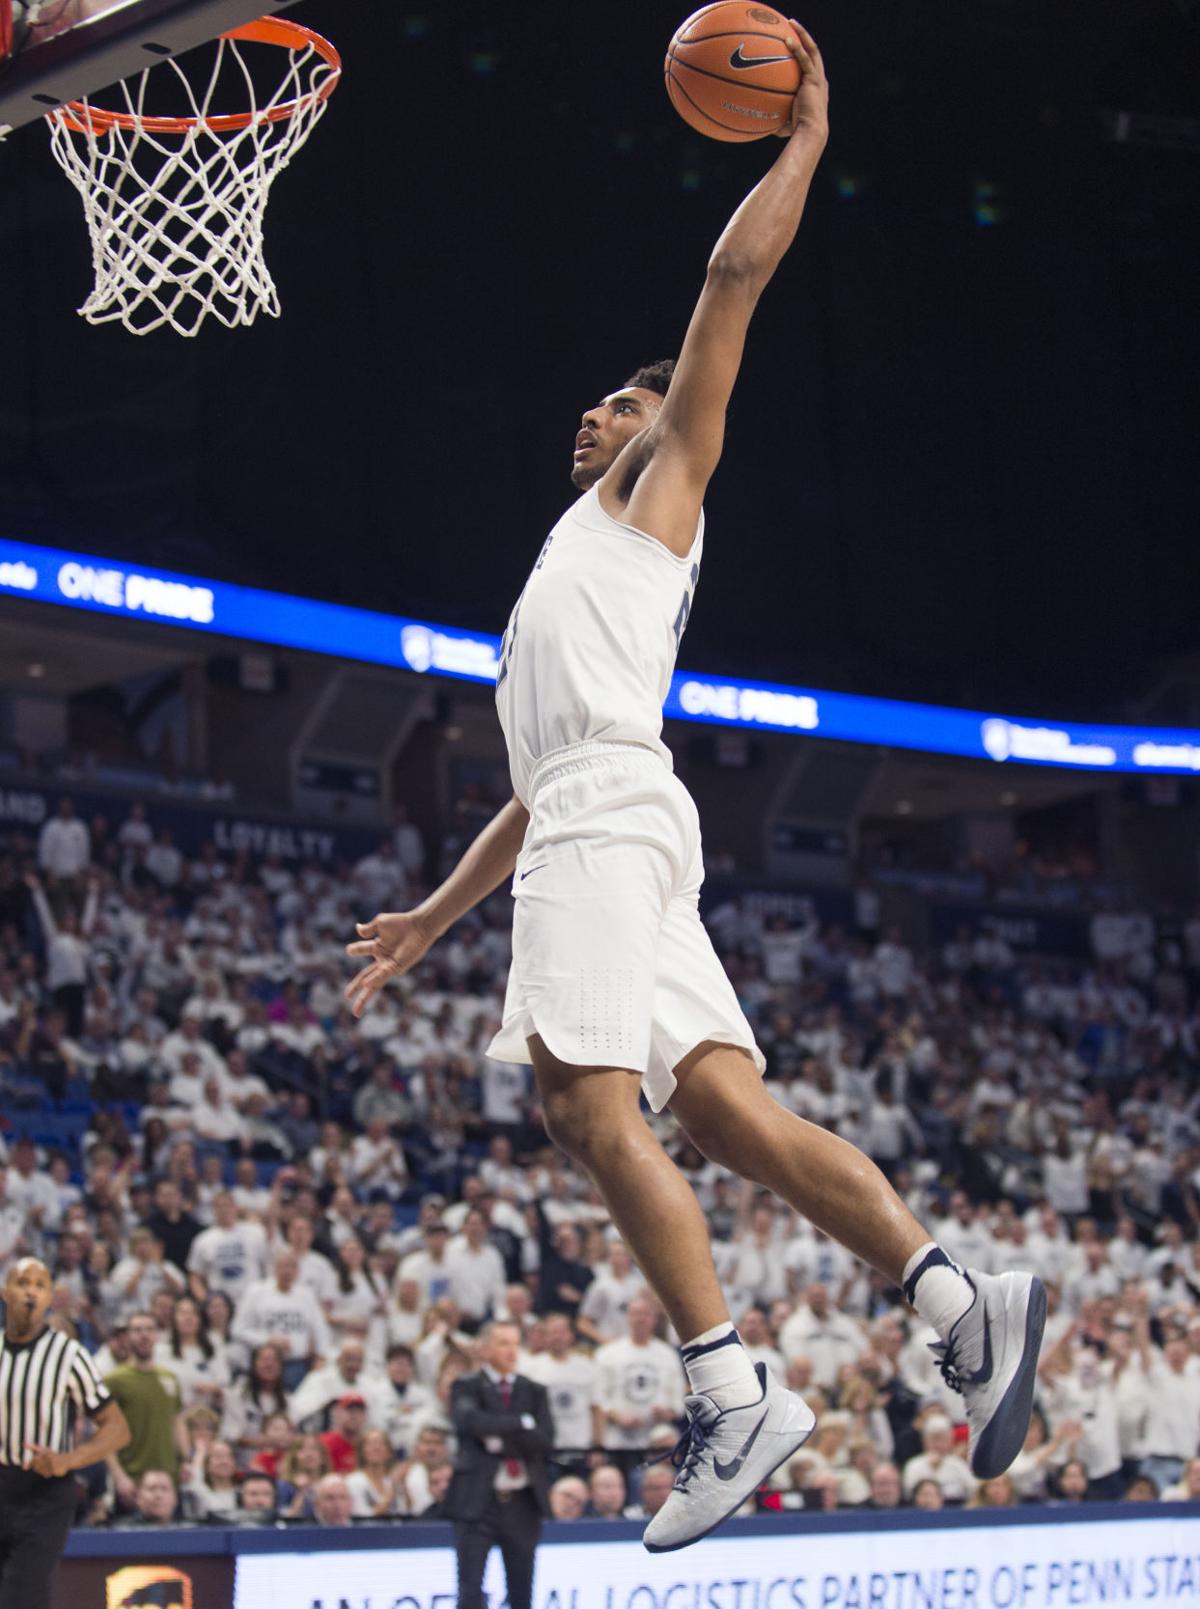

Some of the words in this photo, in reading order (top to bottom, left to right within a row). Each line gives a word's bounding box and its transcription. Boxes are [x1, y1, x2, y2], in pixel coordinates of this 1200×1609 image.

[58, 562, 125, 607] ONE
[214, 820, 335, 861] LOYALTY
[822, 1569, 978, 1609] PARTNER
[991, 1564, 1037, 1608] OF
[1047, 1561, 1134, 1606] PENN
[1144, 1555, 1200, 1599] STA
